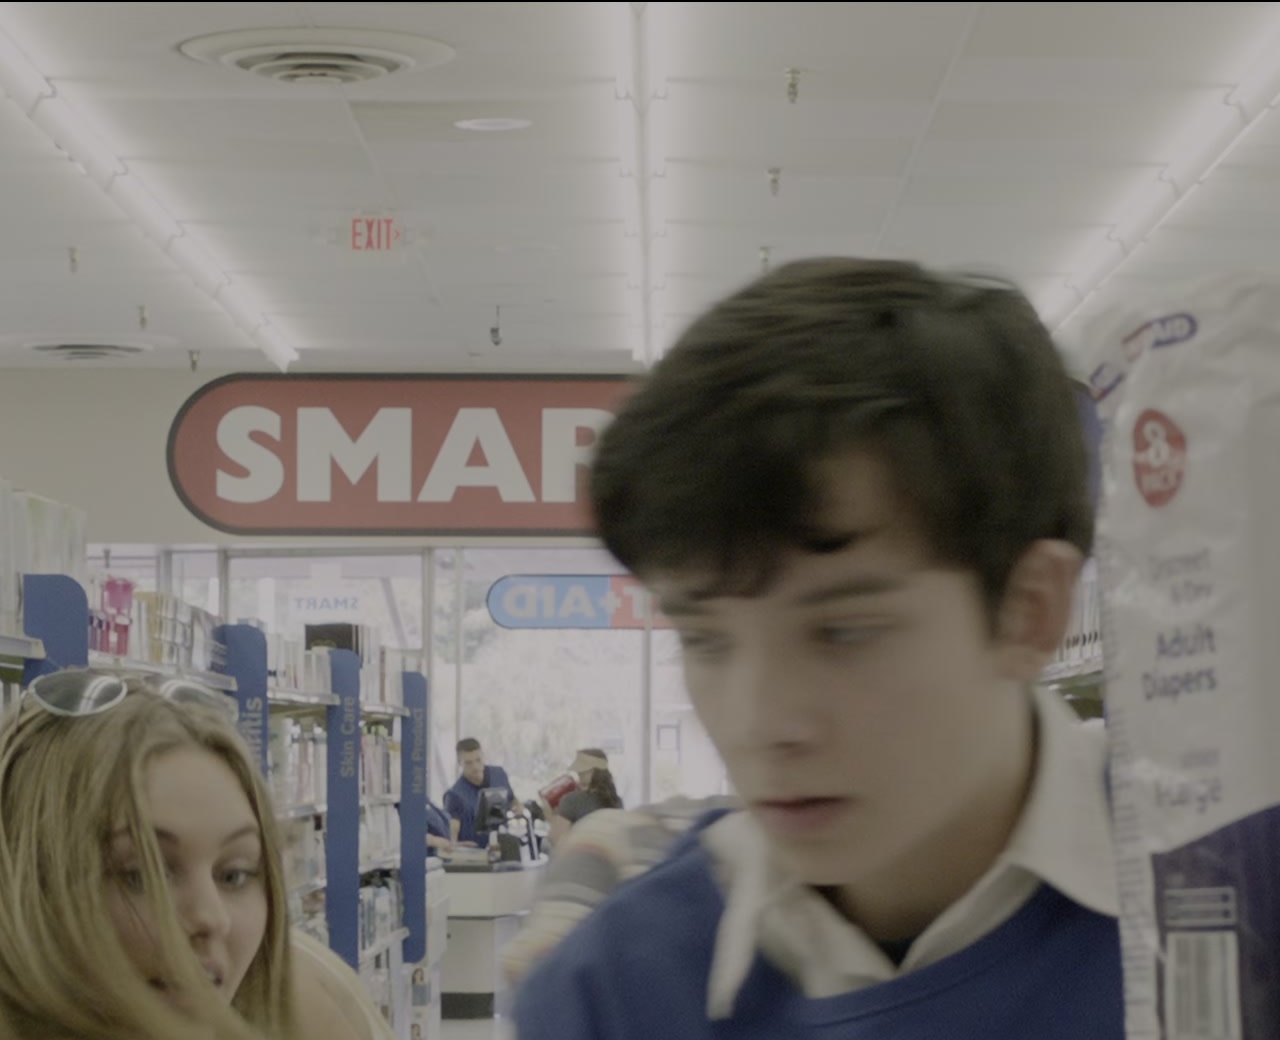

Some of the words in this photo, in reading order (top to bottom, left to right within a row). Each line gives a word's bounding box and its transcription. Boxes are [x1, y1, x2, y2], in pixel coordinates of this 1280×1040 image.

[351, 218, 394, 250] EXIT
[340, 696, 356, 735] Care
[340, 741, 356, 777] Skin
